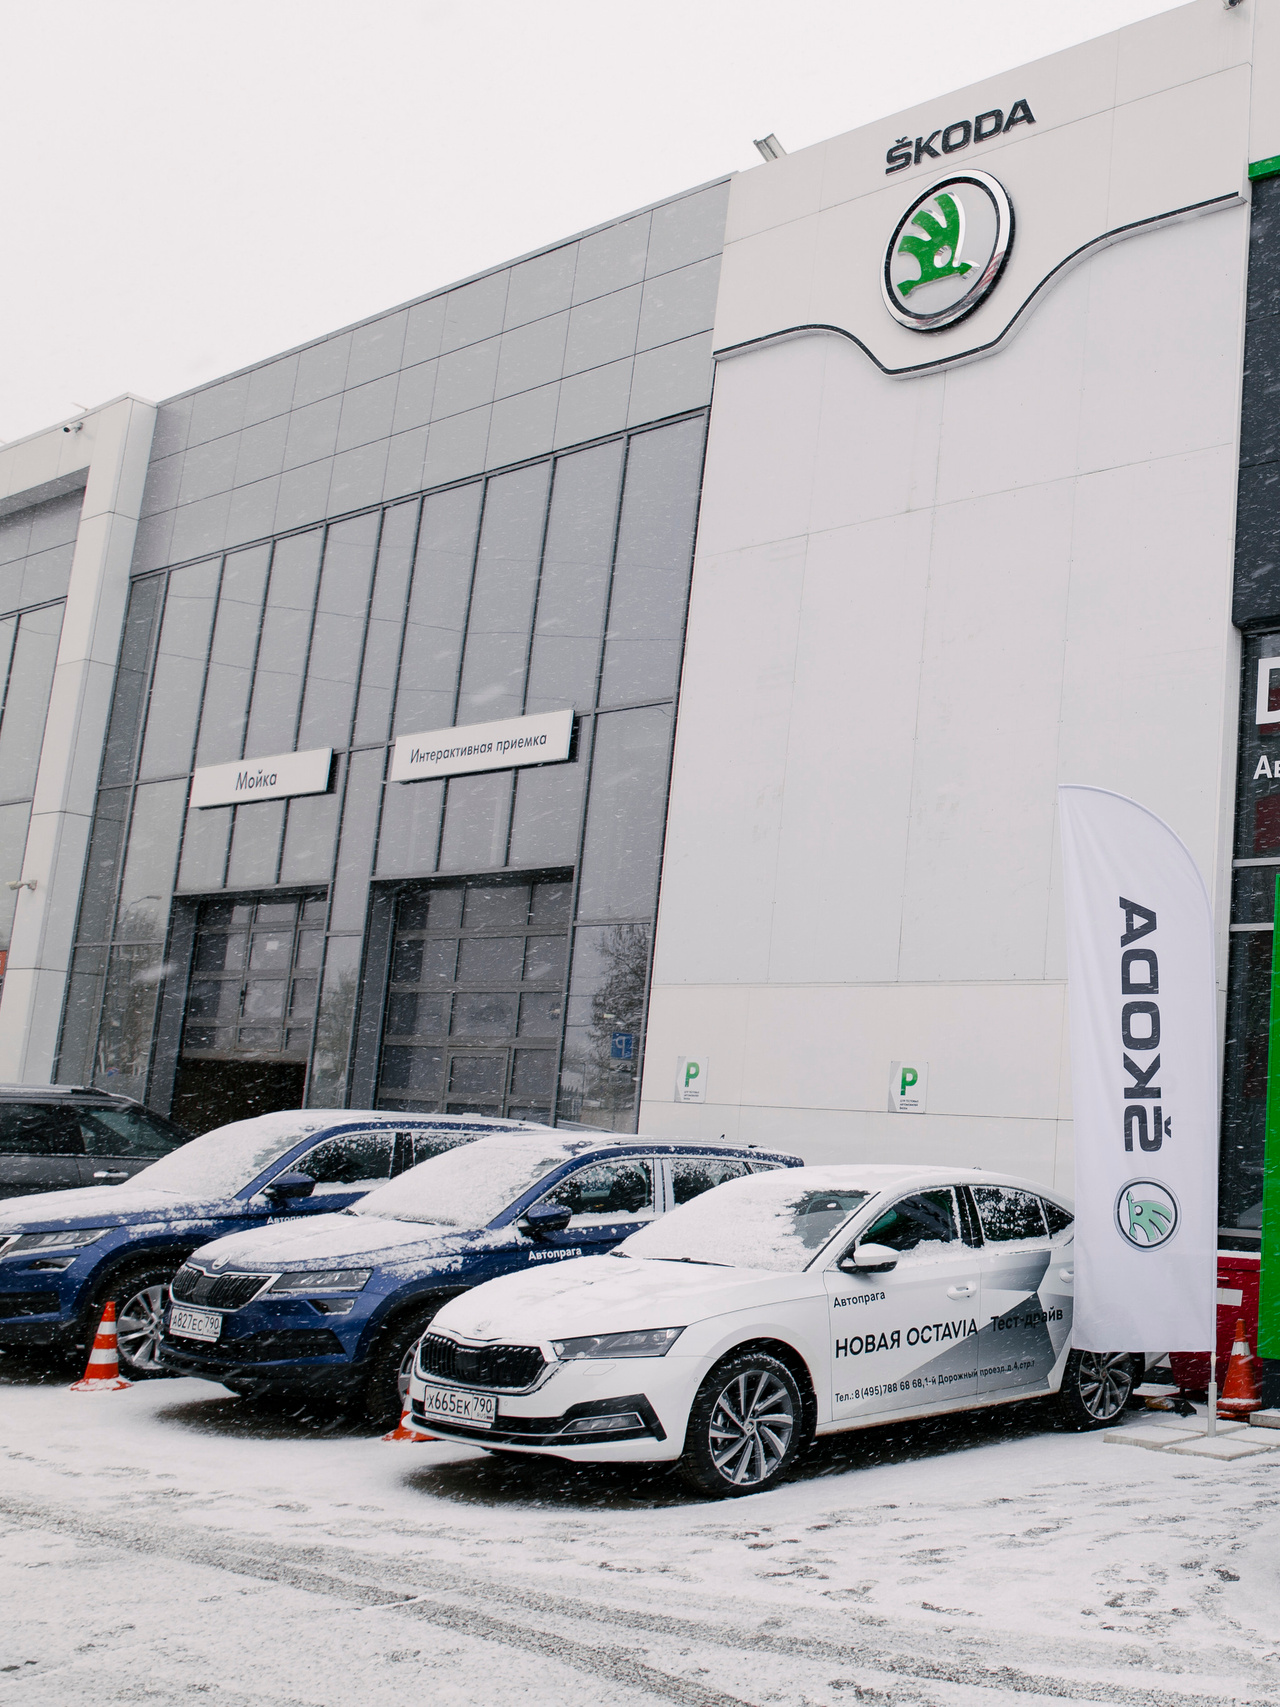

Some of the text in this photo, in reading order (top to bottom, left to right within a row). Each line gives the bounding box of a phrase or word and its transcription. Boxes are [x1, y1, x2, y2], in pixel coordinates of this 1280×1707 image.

[885, 98, 1037, 176] ŠKODA
[410, 732, 547, 764] Интерактивная приемка
[235, 769, 278, 792] Мойка
[900, 1067, 919, 1096] P
[528, 1247, 582, 1261] Автопрага
[833, 1290, 886, 1308] Автопрага
[835, 1305, 1064, 1359] НОВАЯ OCTAVIA Тест-драйв
